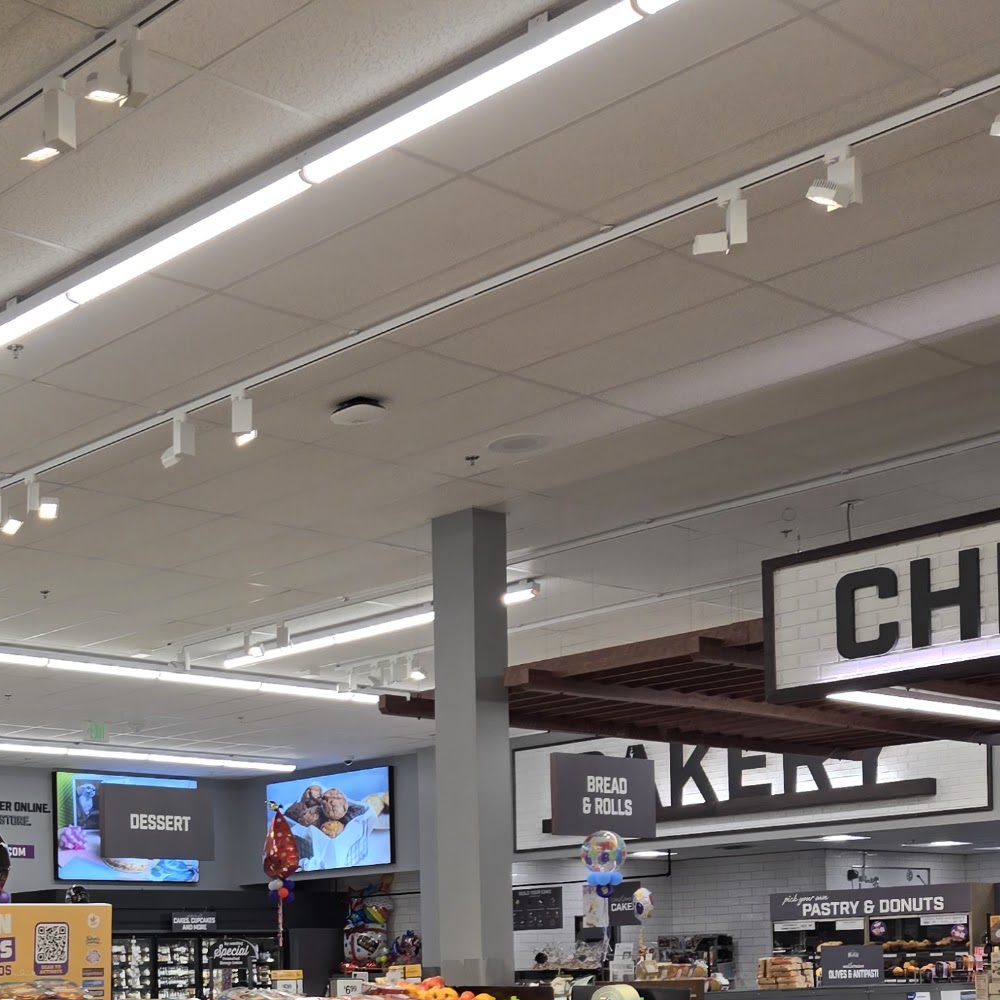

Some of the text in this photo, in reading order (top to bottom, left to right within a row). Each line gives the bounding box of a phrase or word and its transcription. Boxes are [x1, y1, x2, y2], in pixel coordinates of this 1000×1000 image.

[836, 542, 1000, 660] CH
[586, 775, 628, 795] BREAD
[14, 801, 51, 814] ONLINE.
[582, 797, 633, 816] & ROLLS
[129, 813, 191, 832] DESSERT
[610, 902, 635, 912] CAKE
[802, 896, 944, 917] PASTRY & DONUTS
[213, 942, 250, 959] Special
[852, 968, 879, 979] ANTIPASTI
